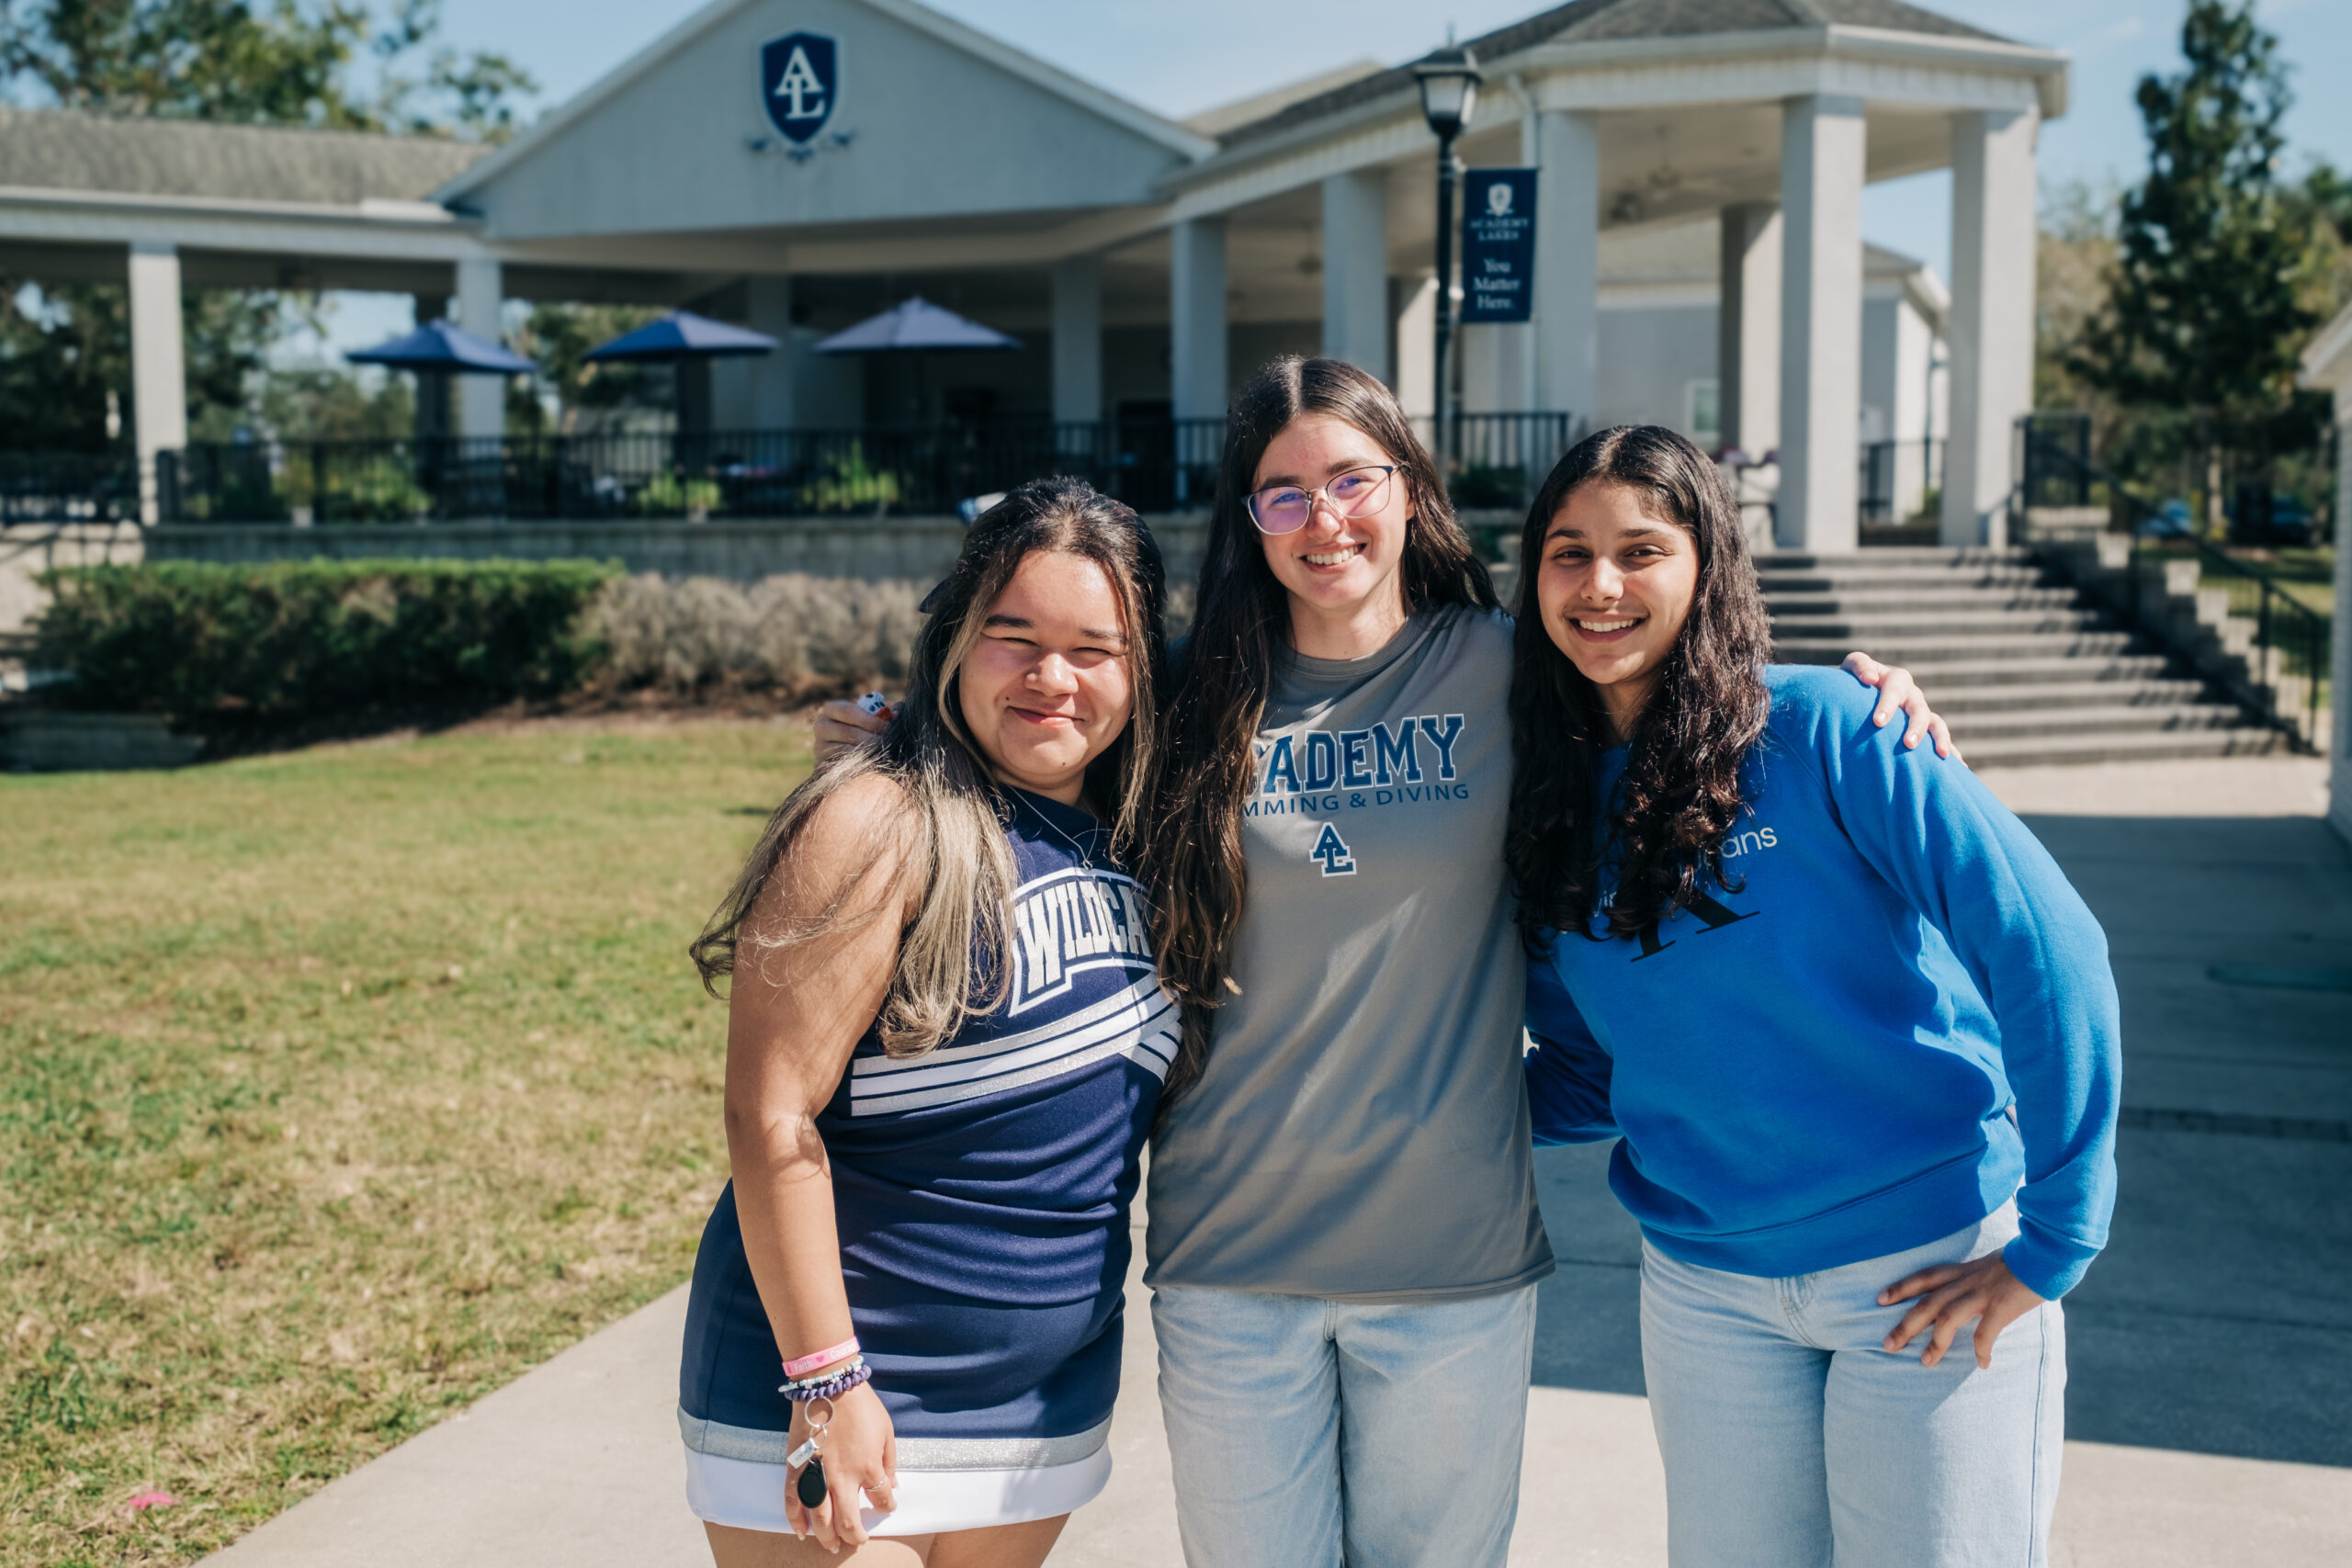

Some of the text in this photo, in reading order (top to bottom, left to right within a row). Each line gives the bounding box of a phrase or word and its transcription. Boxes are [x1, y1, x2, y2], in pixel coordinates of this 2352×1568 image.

[1483, 258, 1511, 273] You
[1473, 276, 1521, 291] Matter
[1246, 714, 1464, 797] ADEMY
[1349, 793, 1366, 808] &
[1376, 784, 1469, 806] DIVING
[1719, 827, 1778, 859] ans
[1015, 881, 1153, 995] WILDCA
[794, 1359, 813, 1372] Faith
